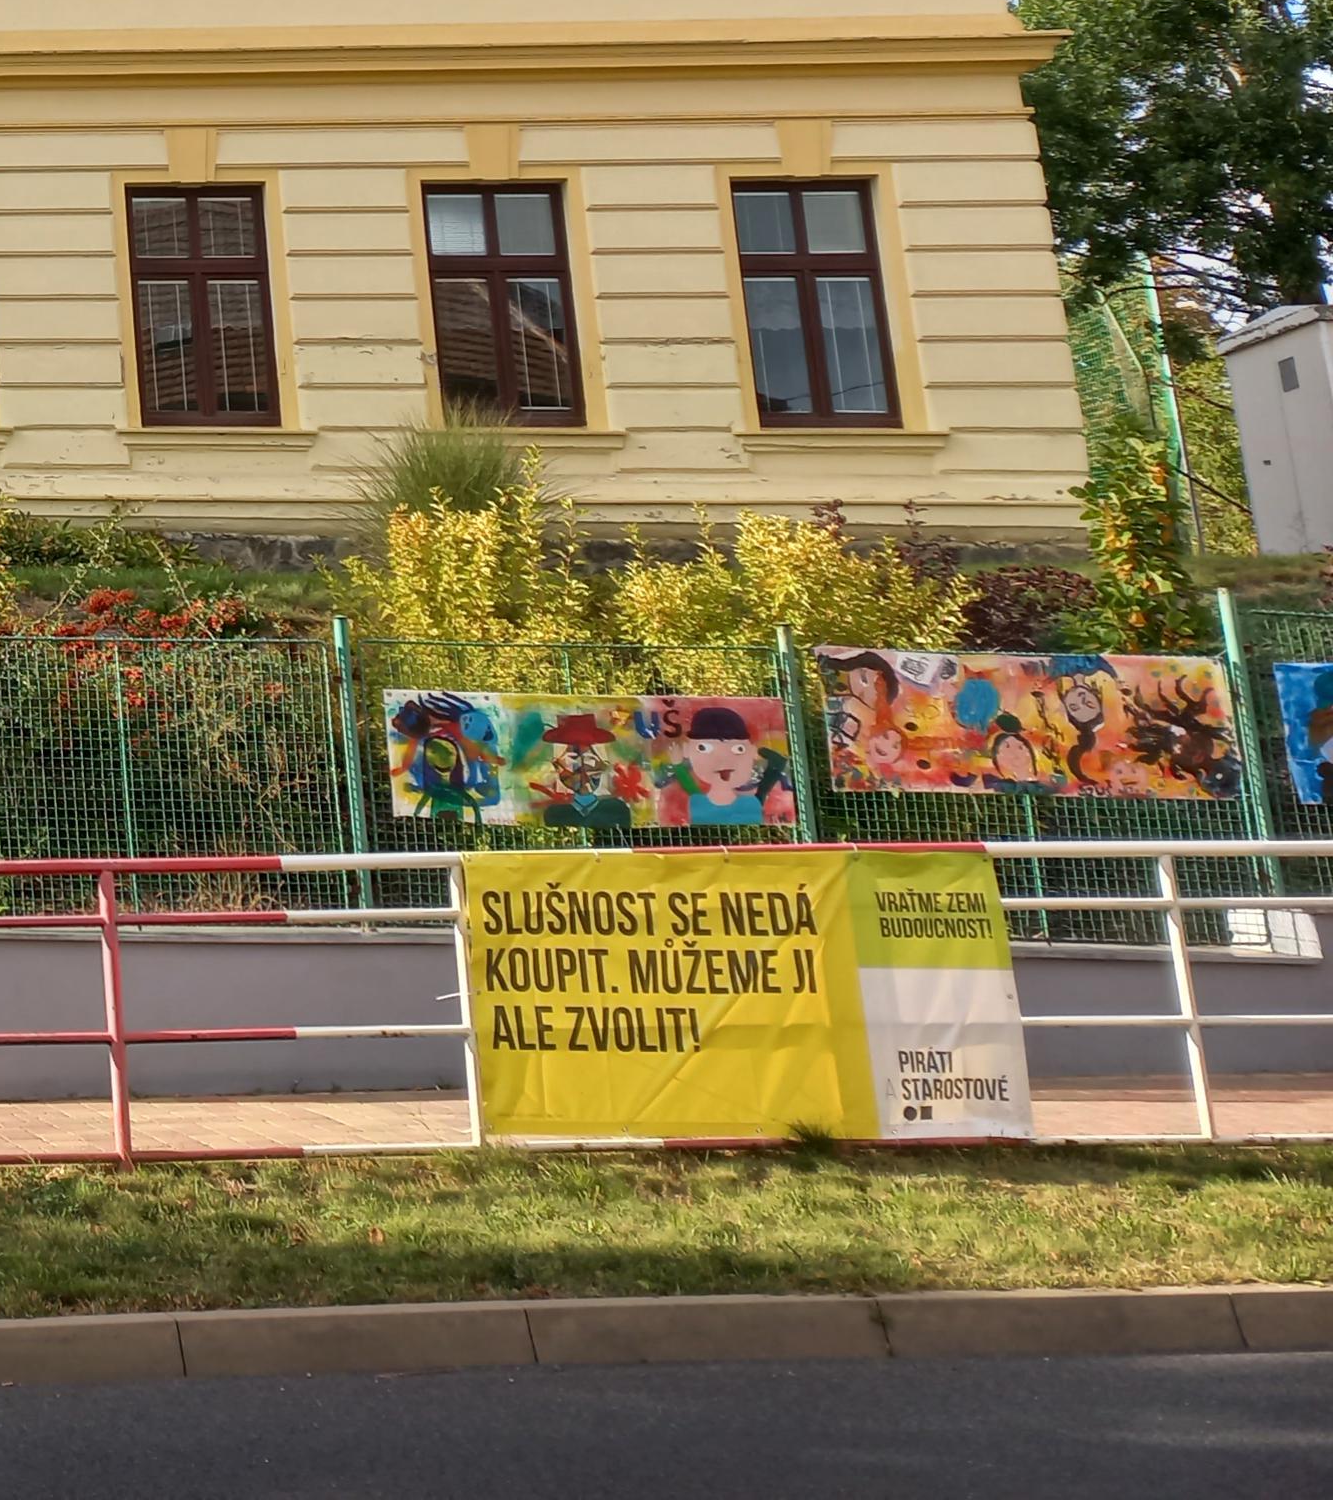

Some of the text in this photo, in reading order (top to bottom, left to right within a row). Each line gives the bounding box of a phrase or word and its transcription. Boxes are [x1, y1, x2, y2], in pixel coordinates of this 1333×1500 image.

[482, 882, 818, 936] SLUŠNOST SE NEDÁ
[874, 887, 987, 914] VRAŤME ZEMI
[879, 917, 993, 939] BUDOUCNOST!
[485, 938, 818, 995] KOUPIT. MŮŽEME JI
[492, 1005, 701, 1053] ALE ZVOLIT!
[898, 1046, 953, 1073] PIRÁTI
[885, 1074, 1010, 1102] A STAROSTOVÉ
